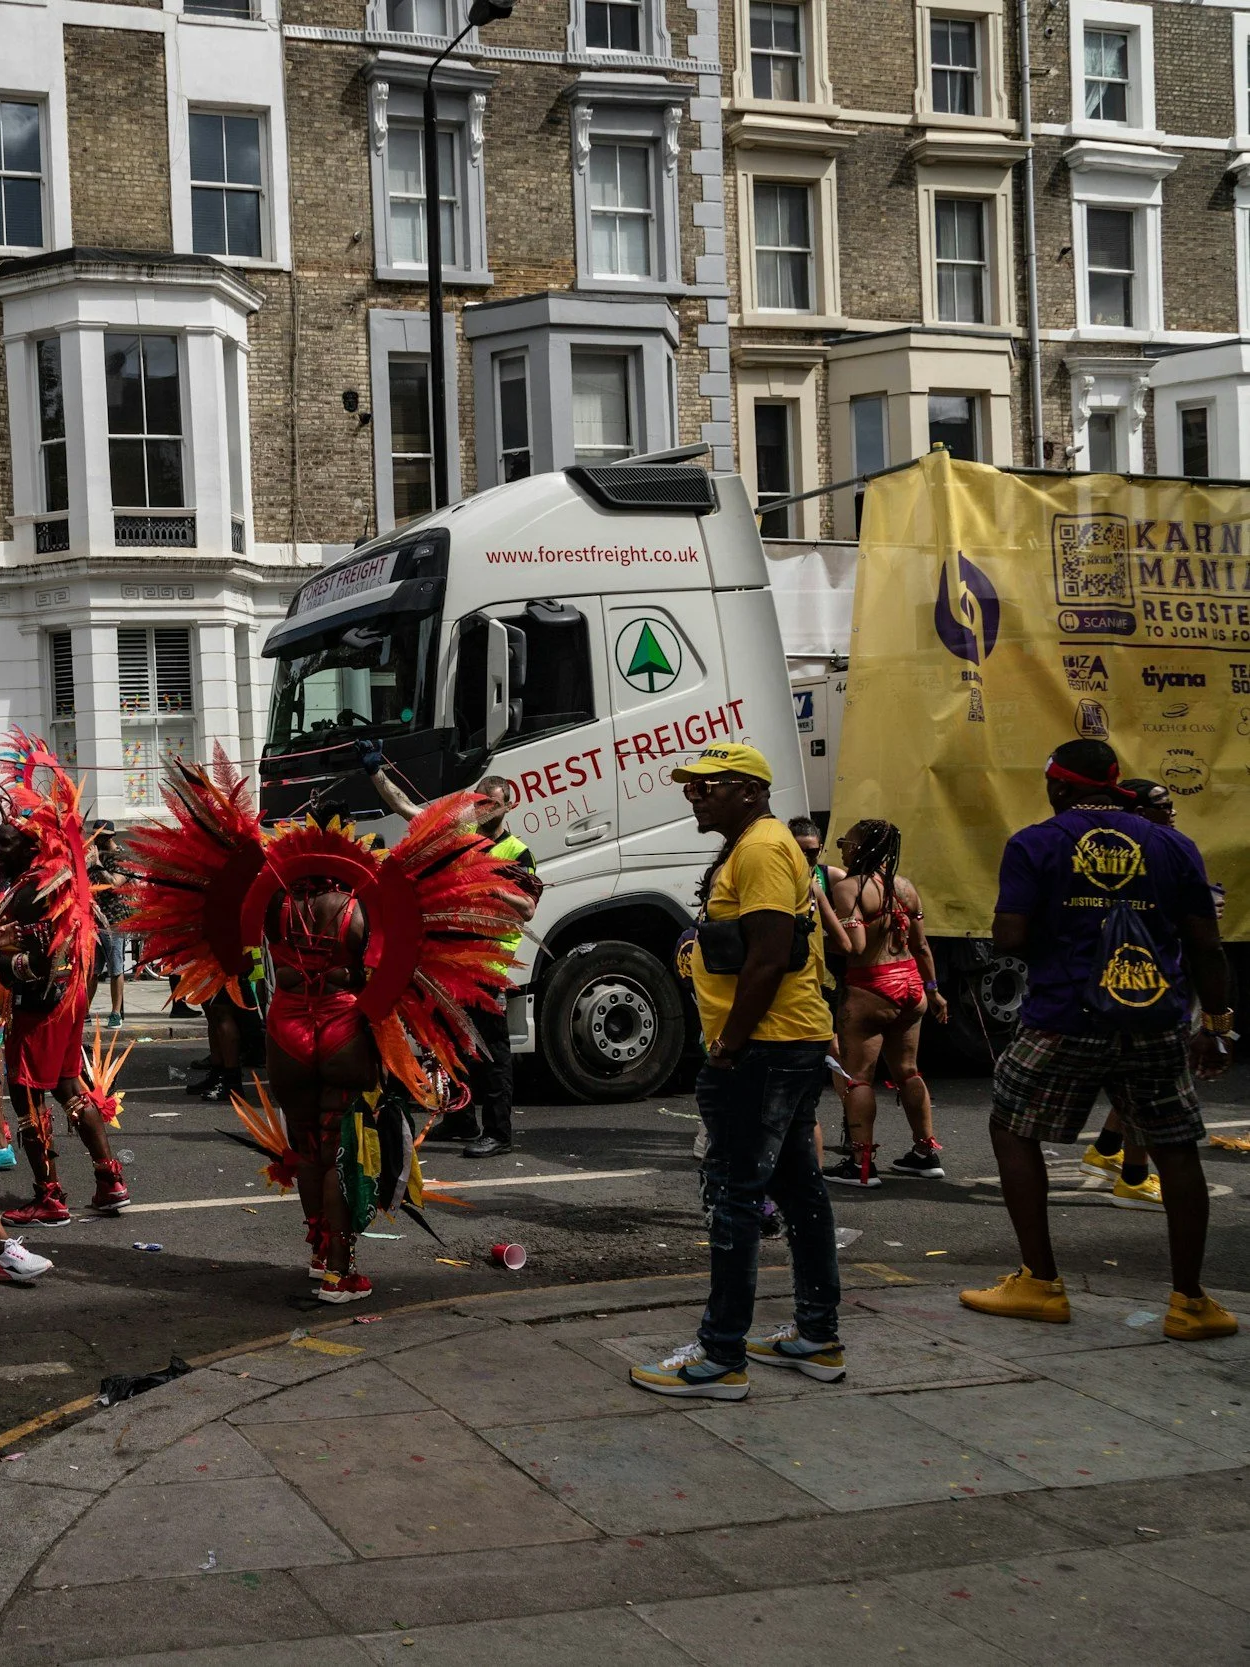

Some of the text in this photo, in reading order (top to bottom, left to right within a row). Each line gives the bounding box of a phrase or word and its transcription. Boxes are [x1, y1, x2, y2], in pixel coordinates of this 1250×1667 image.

[1135, 520, 1250, 554] KARN
[486, 545, 699, 567] www.forestfreight.co.uk
[301, 556, 389, 603] FOREST FREIGHT
[1083, 617, 1116, 629] SCAN
[1145, 625, 1164, 638] TO
[1170, 626, 1208, 639] JOIN
[1212, 627, 1227, 641] US
[1229, 664, 1250, 678] TE
[1141, 665, 1207, 693] tiyana
[1142, 723, 1175, 733] TOUCH
[1190, 723, 1216, 733] CLASS
[506, 698, 745, 811] OREST FREIGHT
[1166, 748, 1195, 757] TWIN
[1169, 783, 1204, 796] CLEAN
[1068, 896, 1104, 908] JUSTICE
